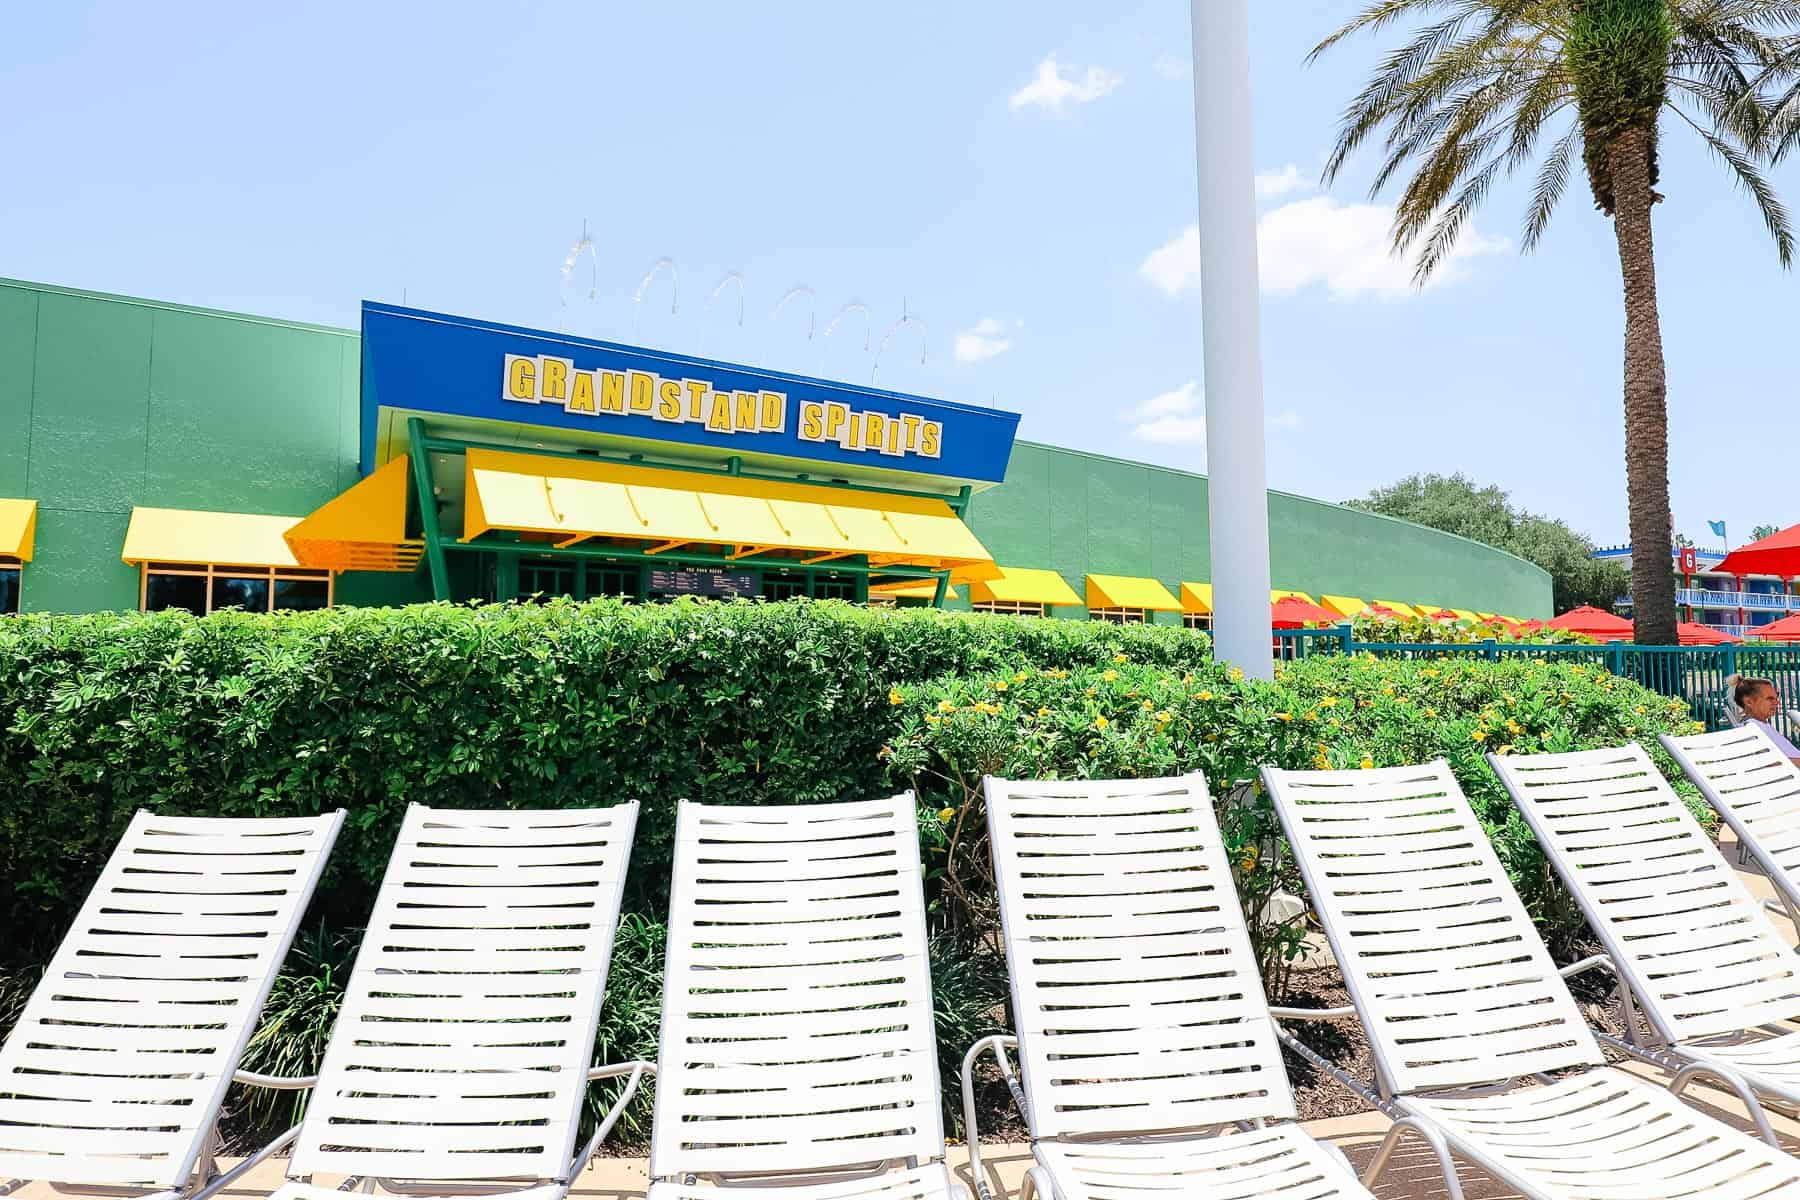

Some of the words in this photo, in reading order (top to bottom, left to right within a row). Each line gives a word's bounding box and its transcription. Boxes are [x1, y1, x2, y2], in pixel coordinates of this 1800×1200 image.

[508, 357, 784, 431] GRANDSTAND
[803, 401, 939, 456] SPIRITS
[1686, 553, 1693, 568] G
